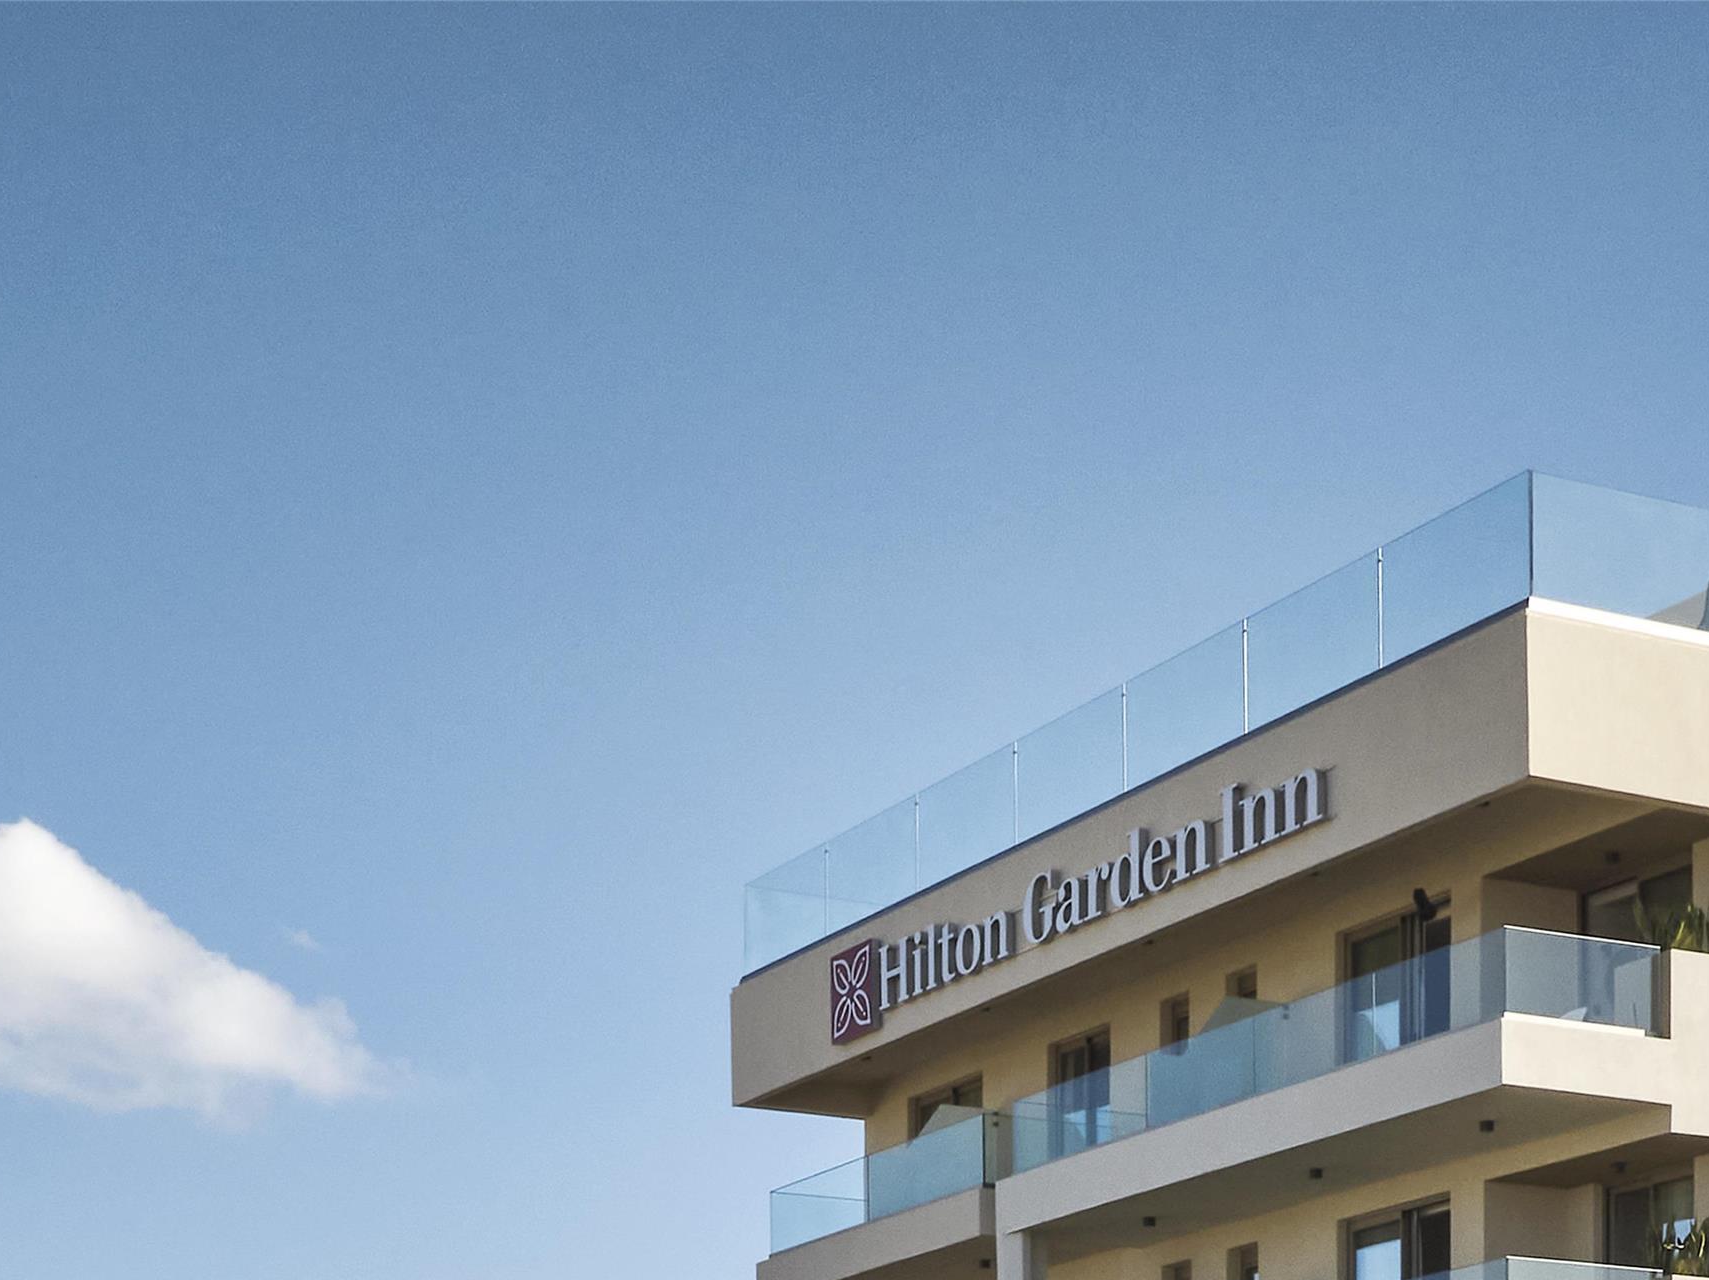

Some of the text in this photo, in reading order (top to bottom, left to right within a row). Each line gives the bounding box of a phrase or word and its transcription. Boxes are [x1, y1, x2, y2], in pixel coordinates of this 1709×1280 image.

[877, 766, 1326, 1011] Hilton Garden Inn
